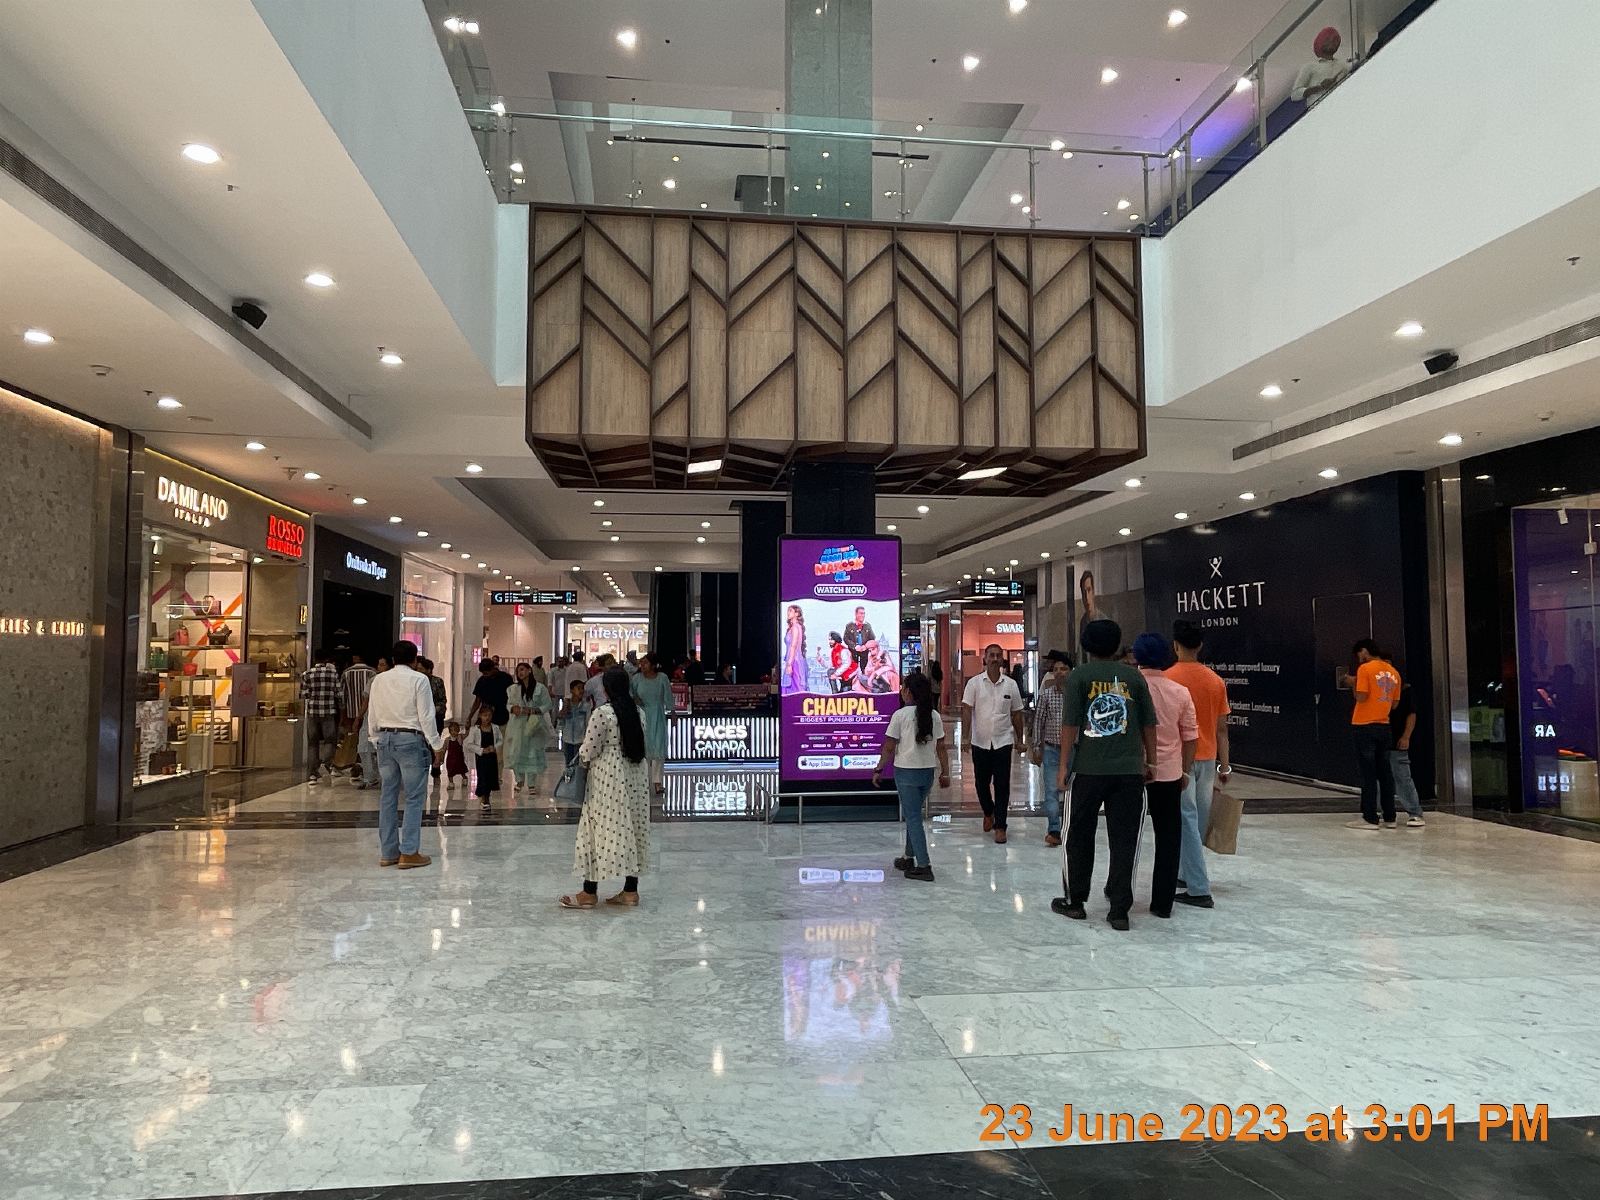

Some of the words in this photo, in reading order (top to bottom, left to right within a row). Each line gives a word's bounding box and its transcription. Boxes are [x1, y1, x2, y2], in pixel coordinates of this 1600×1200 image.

[158, 476, 228, 521] DAMILANO
[174, 507, 211, 528] ITALIA
[269, 515, 304, 545] ROSSO
[816, 586, 844, 594] WATCH
[845, 586, 864, 594] NOW
[1177, 581, 1266, 613] HACKETT
[494, 592, 503, 603] G
[1201, 616, 1239, 628] LONDON
[590, 627, 645, 641] lifestyle
[1235, 662, 1260, 674] improved
[1261, 662, 1280, 675] luxury
[803, 697, 879, 716] CHAUPAL
[1251, 701, 1272, 712] London
[694, 725, 748, 740] FACES
[695, 740, 747, 751] CANADA
